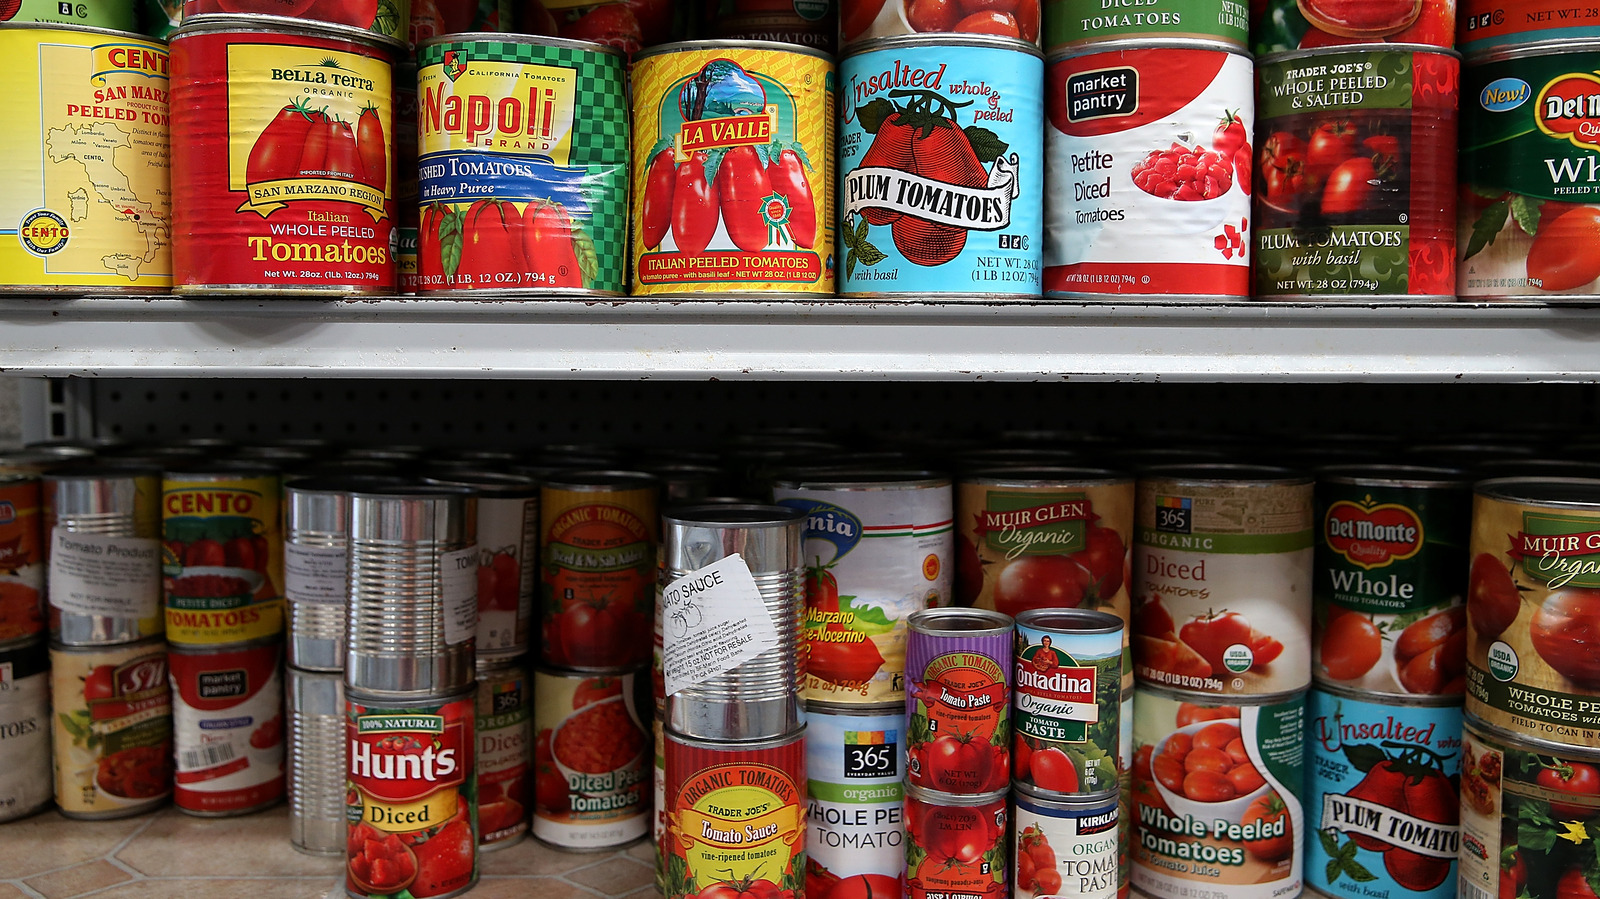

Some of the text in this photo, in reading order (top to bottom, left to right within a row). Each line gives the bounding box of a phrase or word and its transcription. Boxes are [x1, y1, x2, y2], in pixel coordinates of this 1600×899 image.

[1081, 13, 1181, 31] TOMATOES
[1526, 8, 1599, 23] NET 28
[469, 70, 566, 82] CALIFORNIA TOMATOES
[1286, 63, 1364, 79] TRADER JOE'S
[842, 60, 947, 124] Unsalted
[949, 82, 991, 96] whole
[1073, 73, 1126, 94] market
[1274, 76, 1387, 97] WHOLE PEELED
[94, 86, 127, 104] SAN
[304, 88, 354, 98] ORGANIC
[1292, 91, 1363, 109] & SALTED
[1485, 85, 1526, 105] New!
[67, 104, 137, 122] PEELED
[1074, 93, 1126, 116] pantry
[1546, 95, 1584, 118] Del
[974, 109, 1013, 123] peeled
[682, 120, 769, 146] LA VALLE
[485, 138, 550, 150] BRAND
[448, 158, 532, 176] TOMATOES
[1071, 150, 1113, 174] Petite
[254, 185, 382, 205] SAN MARZANO REGION
[431, 183, 494, 198] Heavy Puree
[1074, 176, 1111, 201] Diced
[850, 174, 1003, 223] PLUM TOMATOES
[308, 211, 349, 222] Italian
[1076, 209, 1125, 224] Tomatoes
[22, 228, 70, 238] CENTO
[270, 224, 374, 238] WHOLE PEELED
[1308, 231, 1402, 247] TOMATOES
[248, 236, 386, 264] Tomatoes
[1292, 250, 1361, 266] with basil
[649, 257, 808, 270] ITALIAN PEELED TOMATOES
[977, 257, 1022, 268] NET WT.
[264, 270, 280, 278] Net
[458, 273, 545, 284] LB. 12 OZ.) 794
[854, 268, 898, 281] with basil
[984, 270, 1011, 281] LB 12
[1277, 279, 1379, 290] NET 28 OZ (794g)
[166, 494, 253, 514] CENTO
[552, 508, 645, 538] ORGANIC TOMATOES
[986, 503, 1084, 528] MUIR GLEN
[1160, 510, 1185, 527] 365
[1330, 518, 1416, 543] Del Monte
[58, 536, 102, 554] Tomato
[999, 524, 1074, 561] Organic
[1144, 534, 1213, 549] ORGANIC
[1350, 542, 1386, 558] Quality
[1524, 537, 1579, 552] MUIR
[1146, 555, 1206, 581] Diced
[682, 570, 724, 597] SAUCE
[1145, 581, 1210, 599] TOMATOES
[1329, 569, 1414, 599] Whole
[1361, 597, 1405, 608] TOMATOES
[166, 608, 260, 628] TOMATOES
[728, 634, 753, 650] RESALE
[1493, 649, 1511, 662] USDA
[927, 655, 1001, 682] ORGANIC TOMATOES
[202, 673, 241, 684] market
[944, 679, 966, 689] TRADER
[1016, 663, 1092, 694] Contadina
[1204, 678, 1223, 691] 794g
[202, 683, 241, 695] pantry
[940, 687, 991, 708] Tomato Paste
[499, 694, 518, 708] 365
[1021, 694, 1074, 716] Organic
[1508, 687, 1572, 710] WHOLE
[936, 710, 967, 721] vine-ripened
[1508, 700, 1578, 721] TOMATOES
[362, 719, 437, 729] 100% NATURAL
[1025, 722, 1066, 739] PASTE
[1030, 716, 1059, 727] TOMATO
[1511, 716, 1594, 738] FIELD TO CAN IN
[1314, 714, 1436, 752] Unsalted
[851, 746, 890, 771] 365
[569, 774, 613, 792] Diced
[684, 770, 793, 805] ORGANIC TOMATOES
[569, 791, 639, 811] Tomatoes
[843, 786, 897, 801] organic
[370, 805, 430, 824] Diced
[708, 803, 768, 817] TRADER JOE'S
[1333, 800, 1382, 832] PLUM
[1139, 802, 1206, 837] Whole
[1214, 815, 1285, 840] Peeled
[702, 820, 778, 843] Tomato Sauce
[817, 828, 902, 849] TOMATO
[1139, 826, 1243, 864] Tomatoes
[701, 848, 777, 862] vine-ripened tomatoes
[1190, 864, 1220, 877] Juice
[1363, 885, 1390, 899] basil
